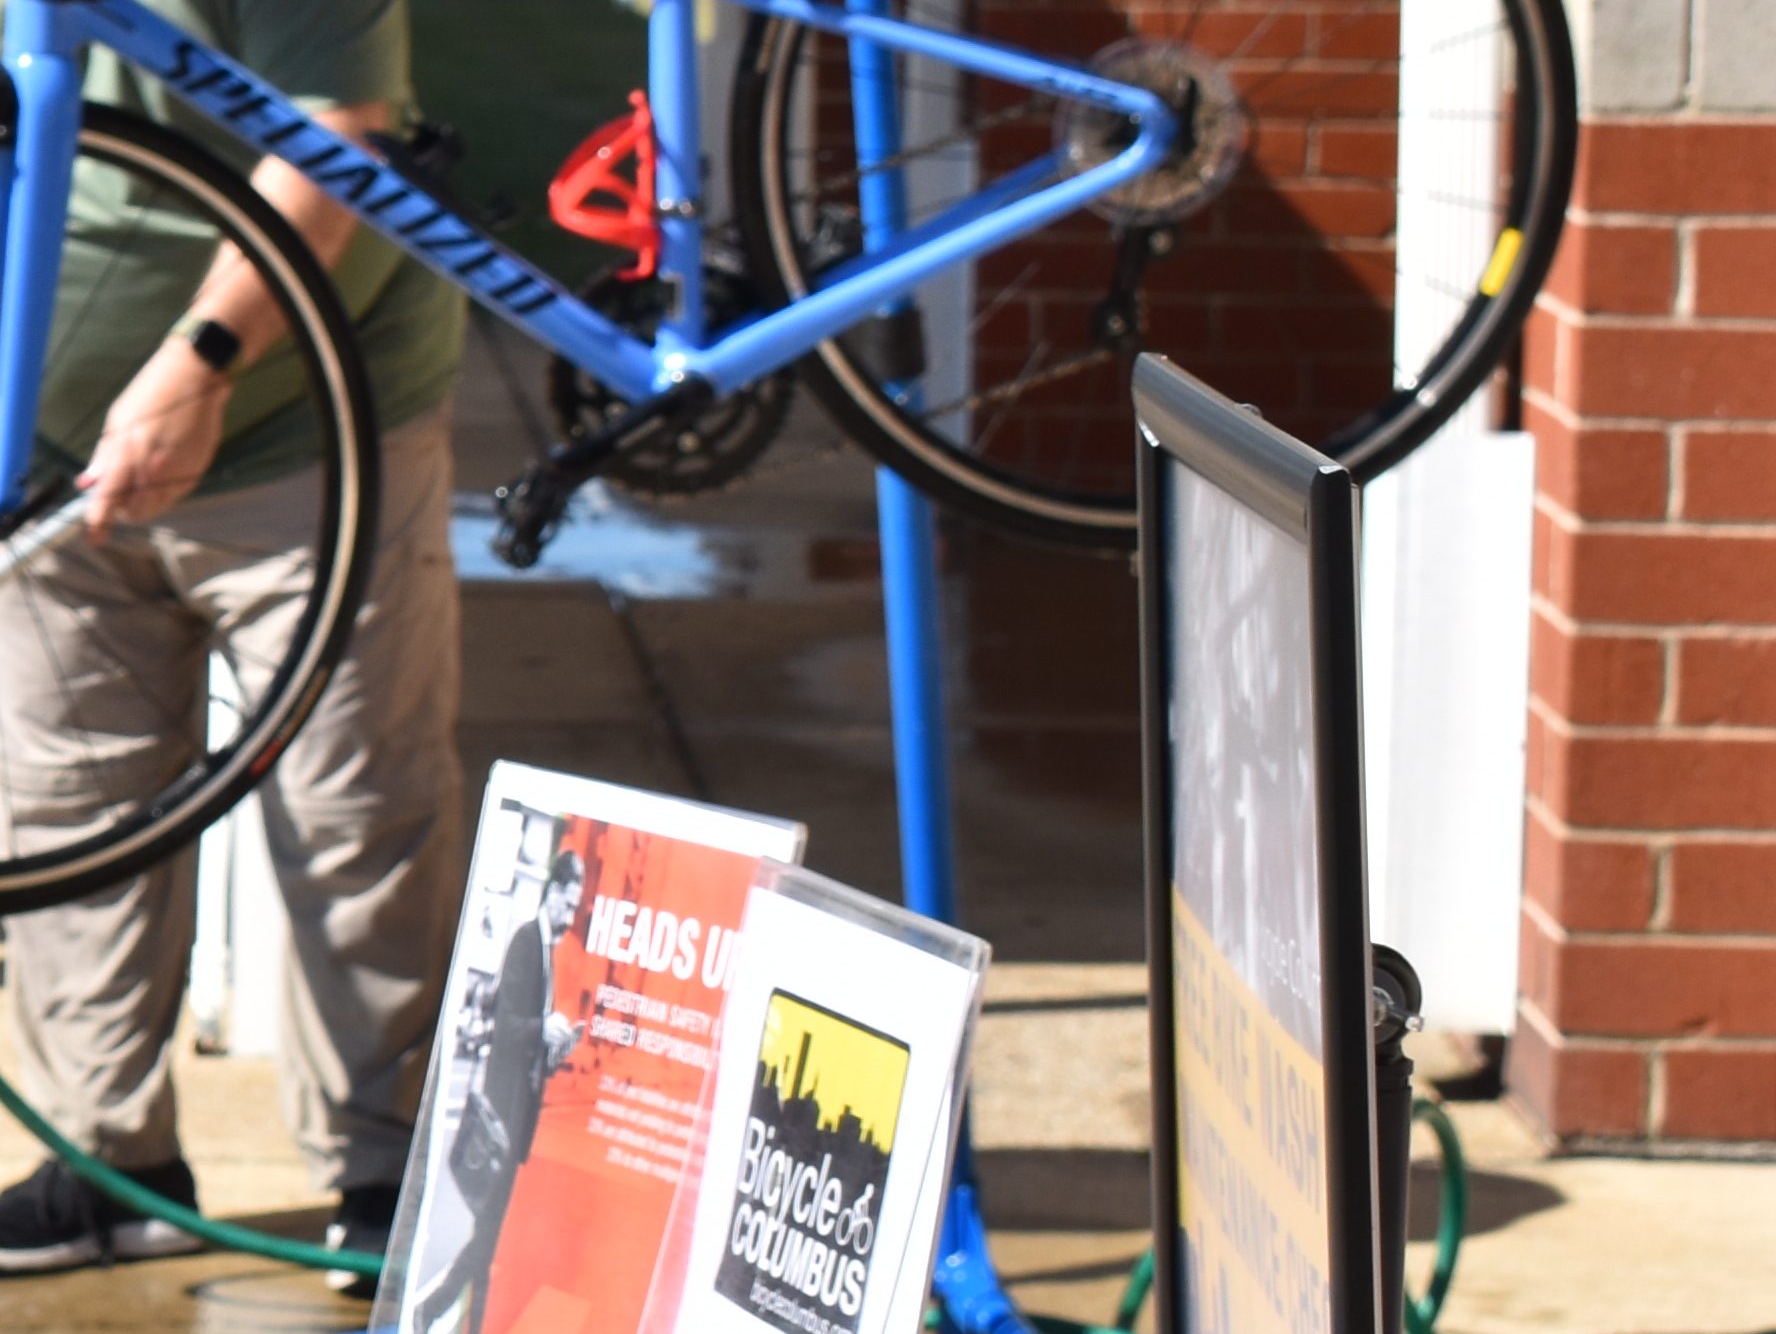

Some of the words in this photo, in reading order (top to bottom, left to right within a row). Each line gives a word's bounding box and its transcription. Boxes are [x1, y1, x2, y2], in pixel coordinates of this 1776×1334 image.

[166, 40, 559, 315] SPECIALIZED
[586, 894, 701, 980] HEADS
[738, 1116, 843, 1236] Bicycle
[730, 1203, 866, 1316] COLUMBUS
